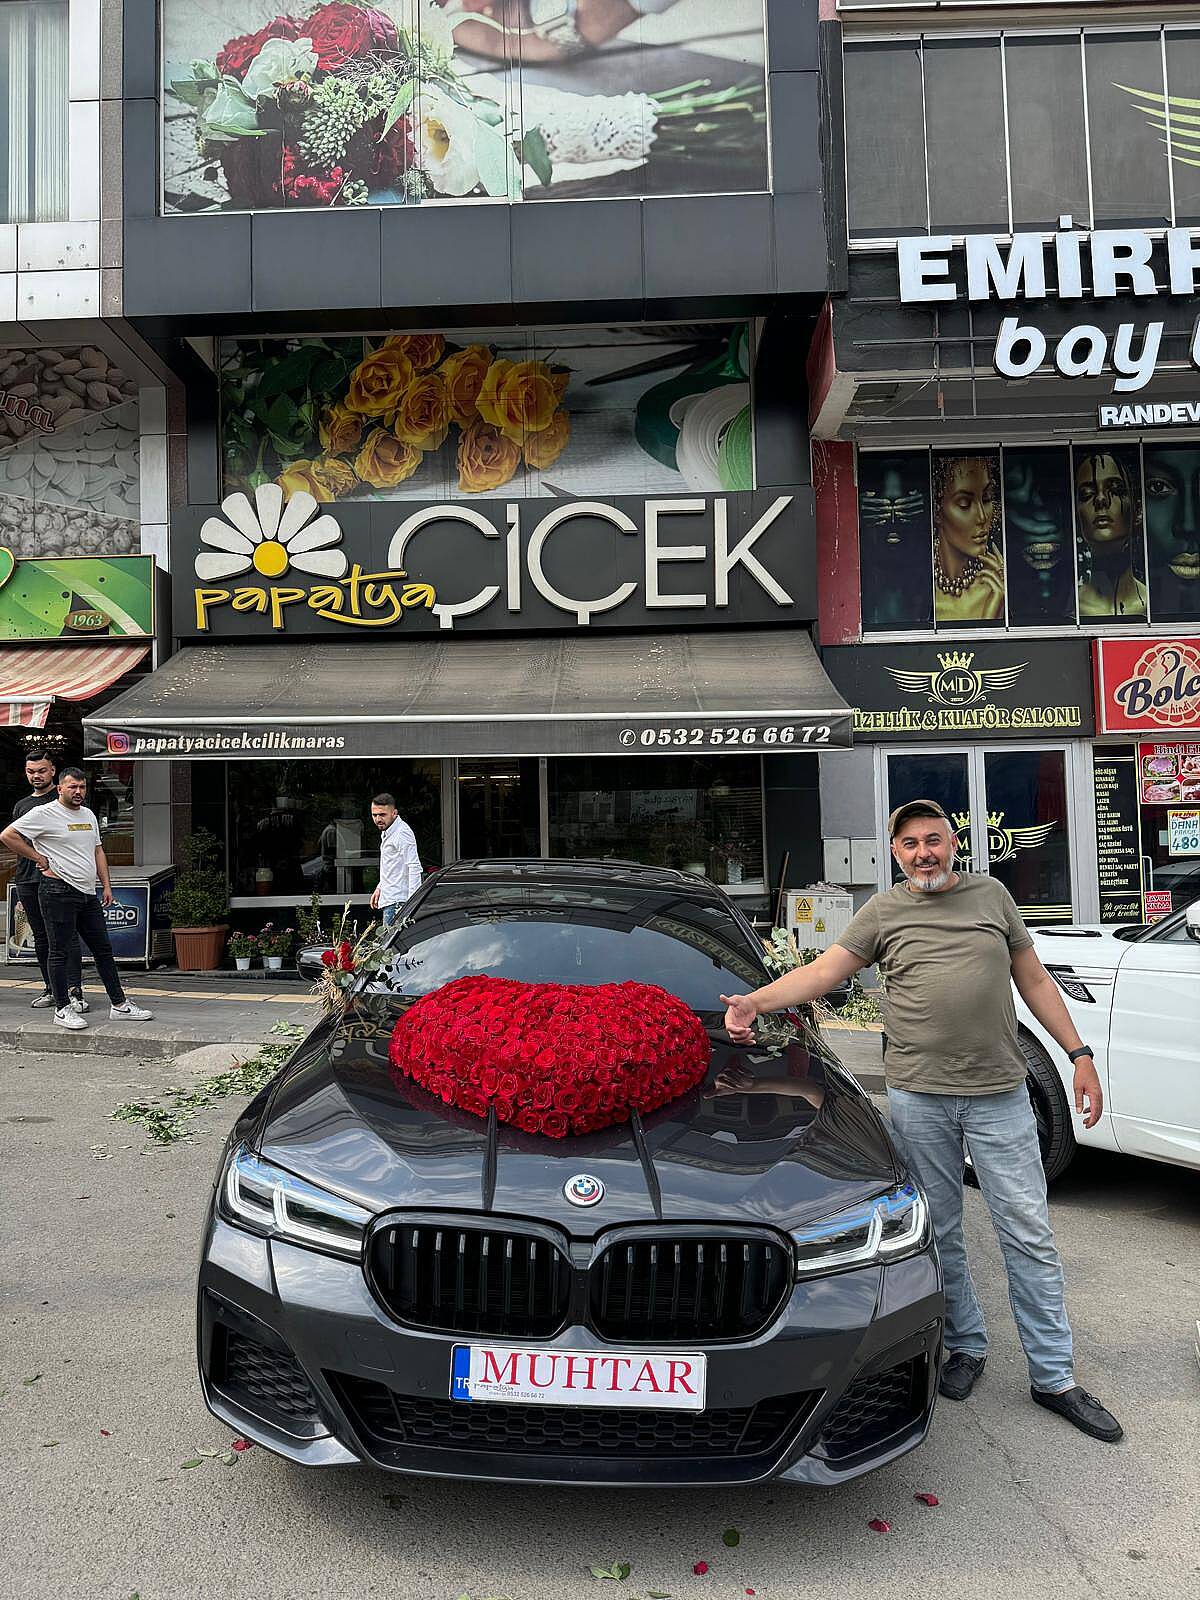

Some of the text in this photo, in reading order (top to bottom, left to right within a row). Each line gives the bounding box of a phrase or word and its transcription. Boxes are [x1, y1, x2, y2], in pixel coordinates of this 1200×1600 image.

[993, 316, 1165, 392] bay
[387, 495, 795, 629] ÇİÇEK
[194, 564, 437, 631] papatya
[71, 614, 104, 627] 1963
[1170, 700, 1191, 714] hindi
[852, 704, 1082, 732] ÜZELLİK & KUAFÖR SALONU
[134, 732, 346, 753] papatyacicekcilikmaras
[640, 725, 832, 746] 0532 526 66 72
[1154, 744, 1184, 754] Hindi
[989, 835, 1004, 850] D
[1171, 836, 1199, 851] 480
[103, 909, 136, 921] PEDO
[478, 1350, 698, 1395] MUHTAR
[455, 1377, 470, 1390] TR
